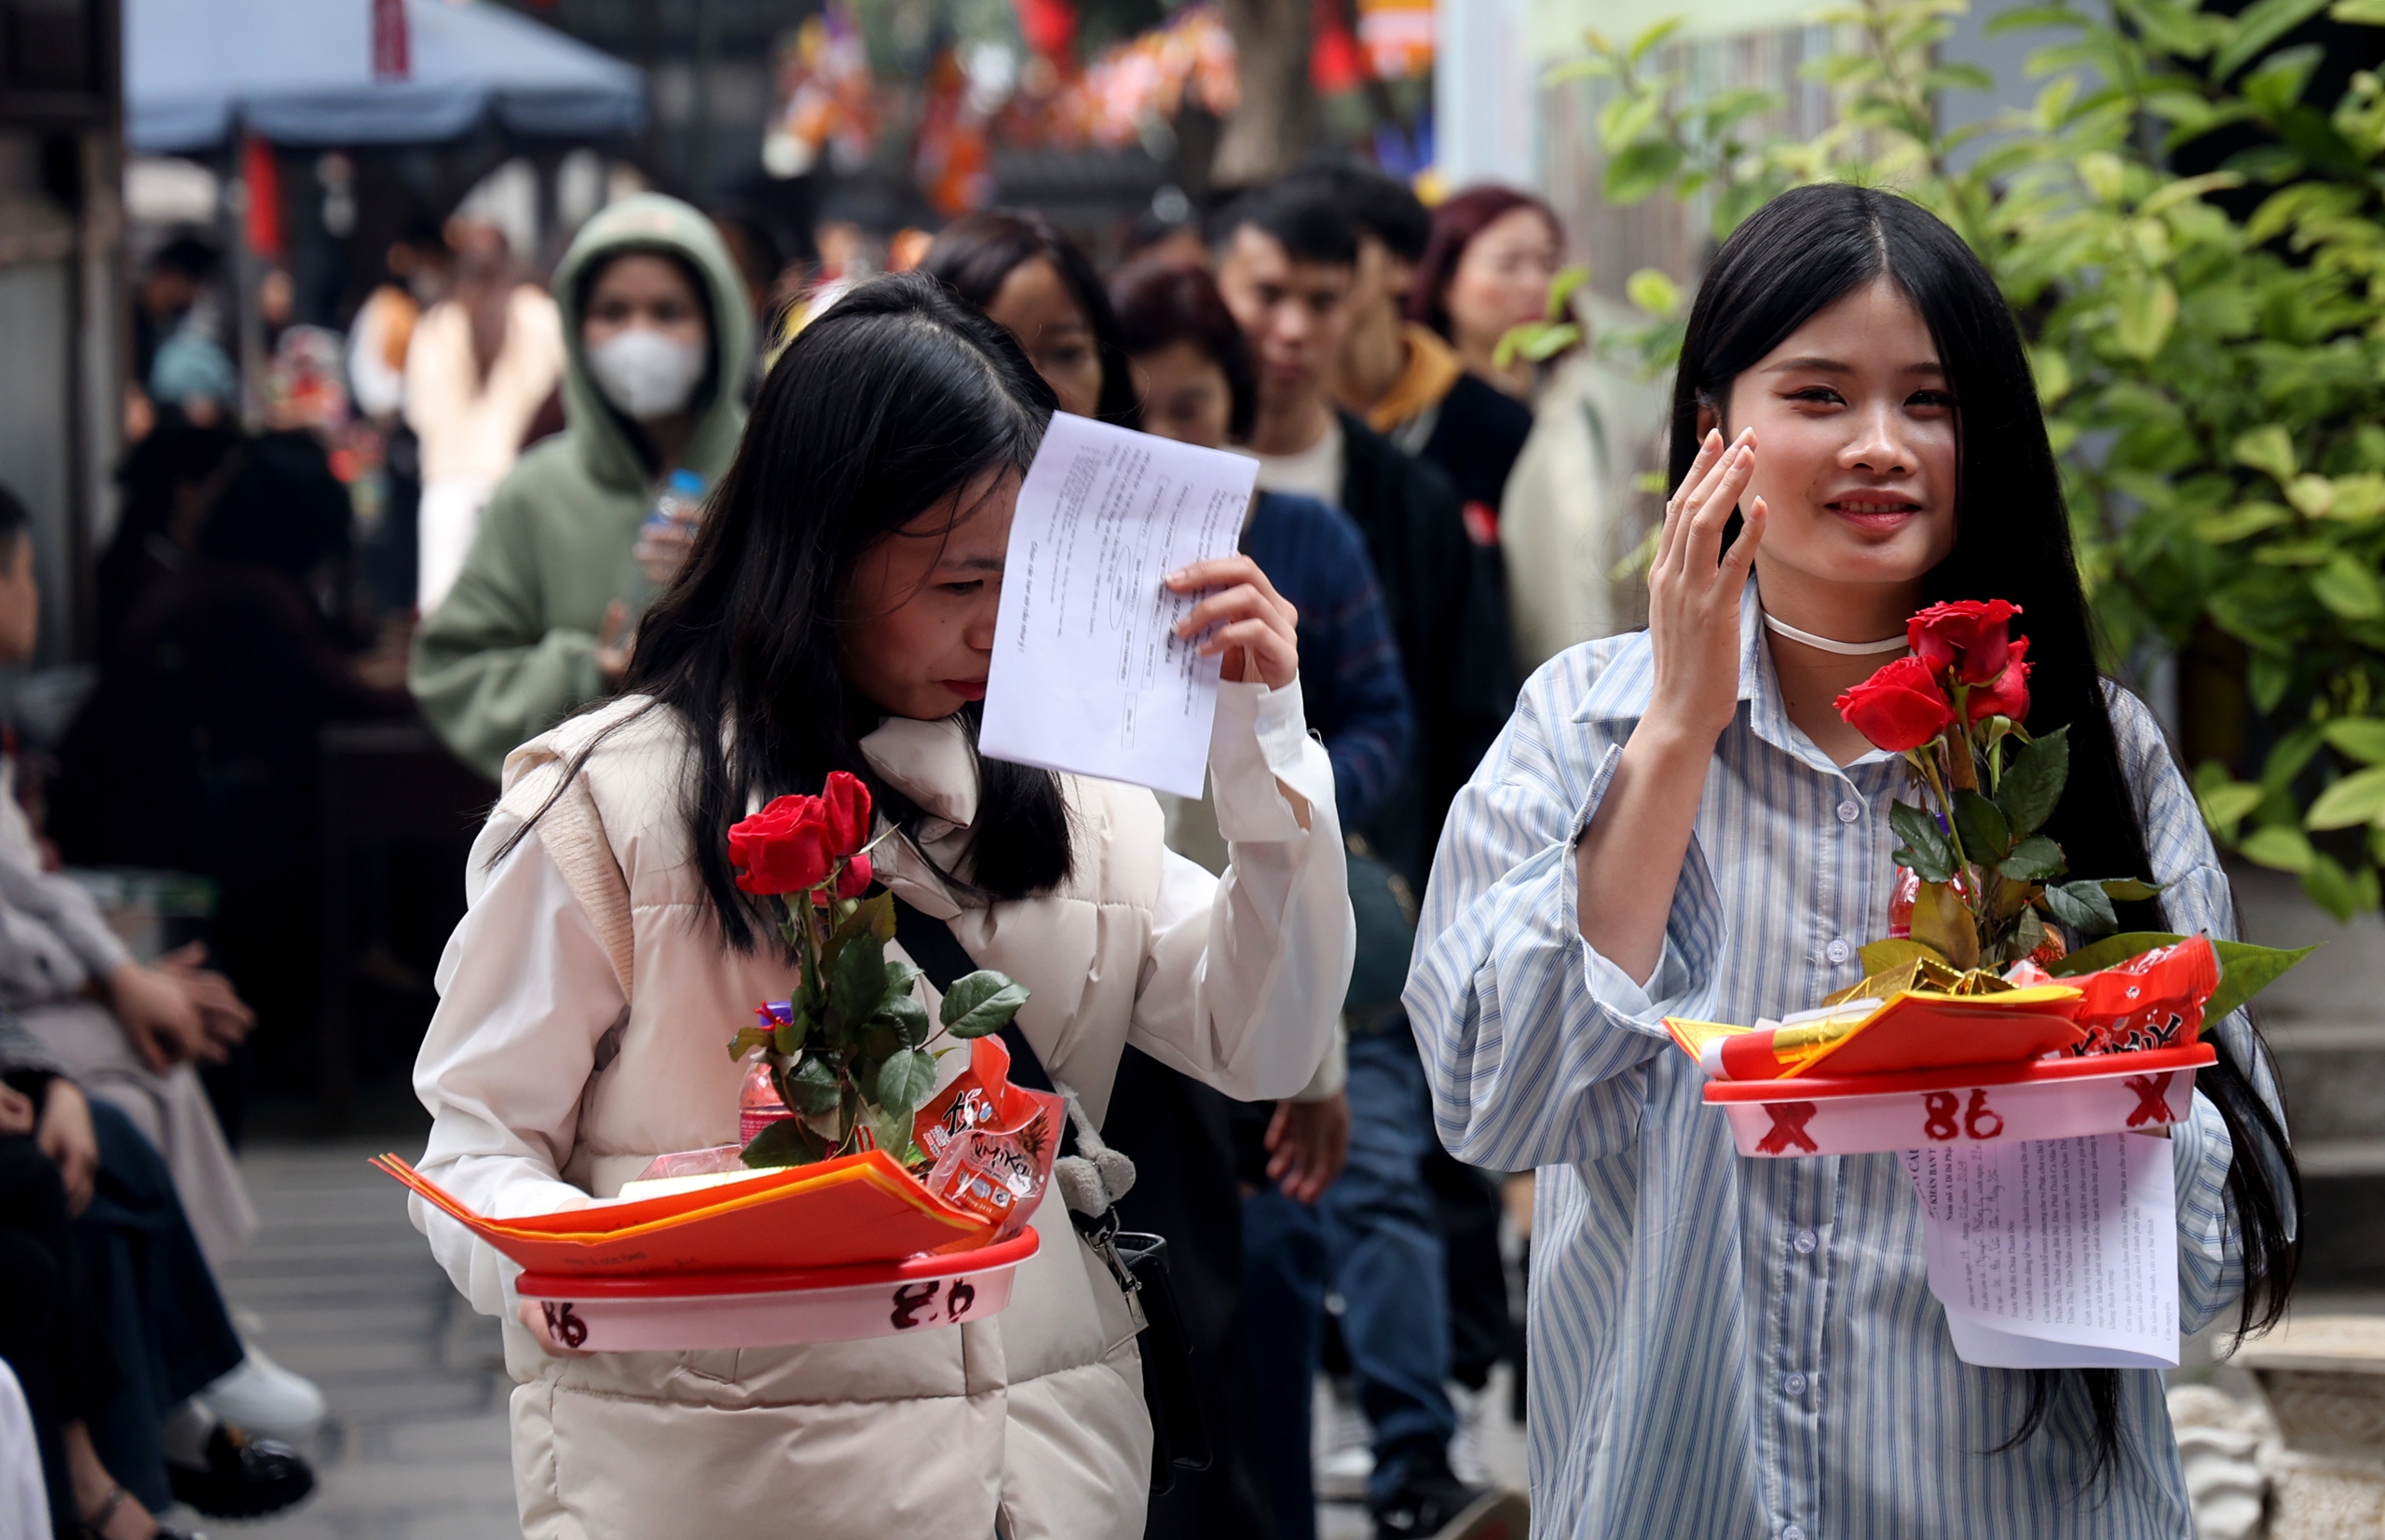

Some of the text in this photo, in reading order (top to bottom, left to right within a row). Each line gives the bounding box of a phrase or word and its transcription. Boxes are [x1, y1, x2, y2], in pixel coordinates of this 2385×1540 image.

[1921, 1087, 2005, 1141] 86
[1956, 1161, 1967, 1182] 2024
[1945, 1175, 1953, 1183] Di
[1945, 1192, 1953, 1202] mô
[2052, 1250, 2062, 1266] Long
[2025, 1309, 2034, 1321] Con
